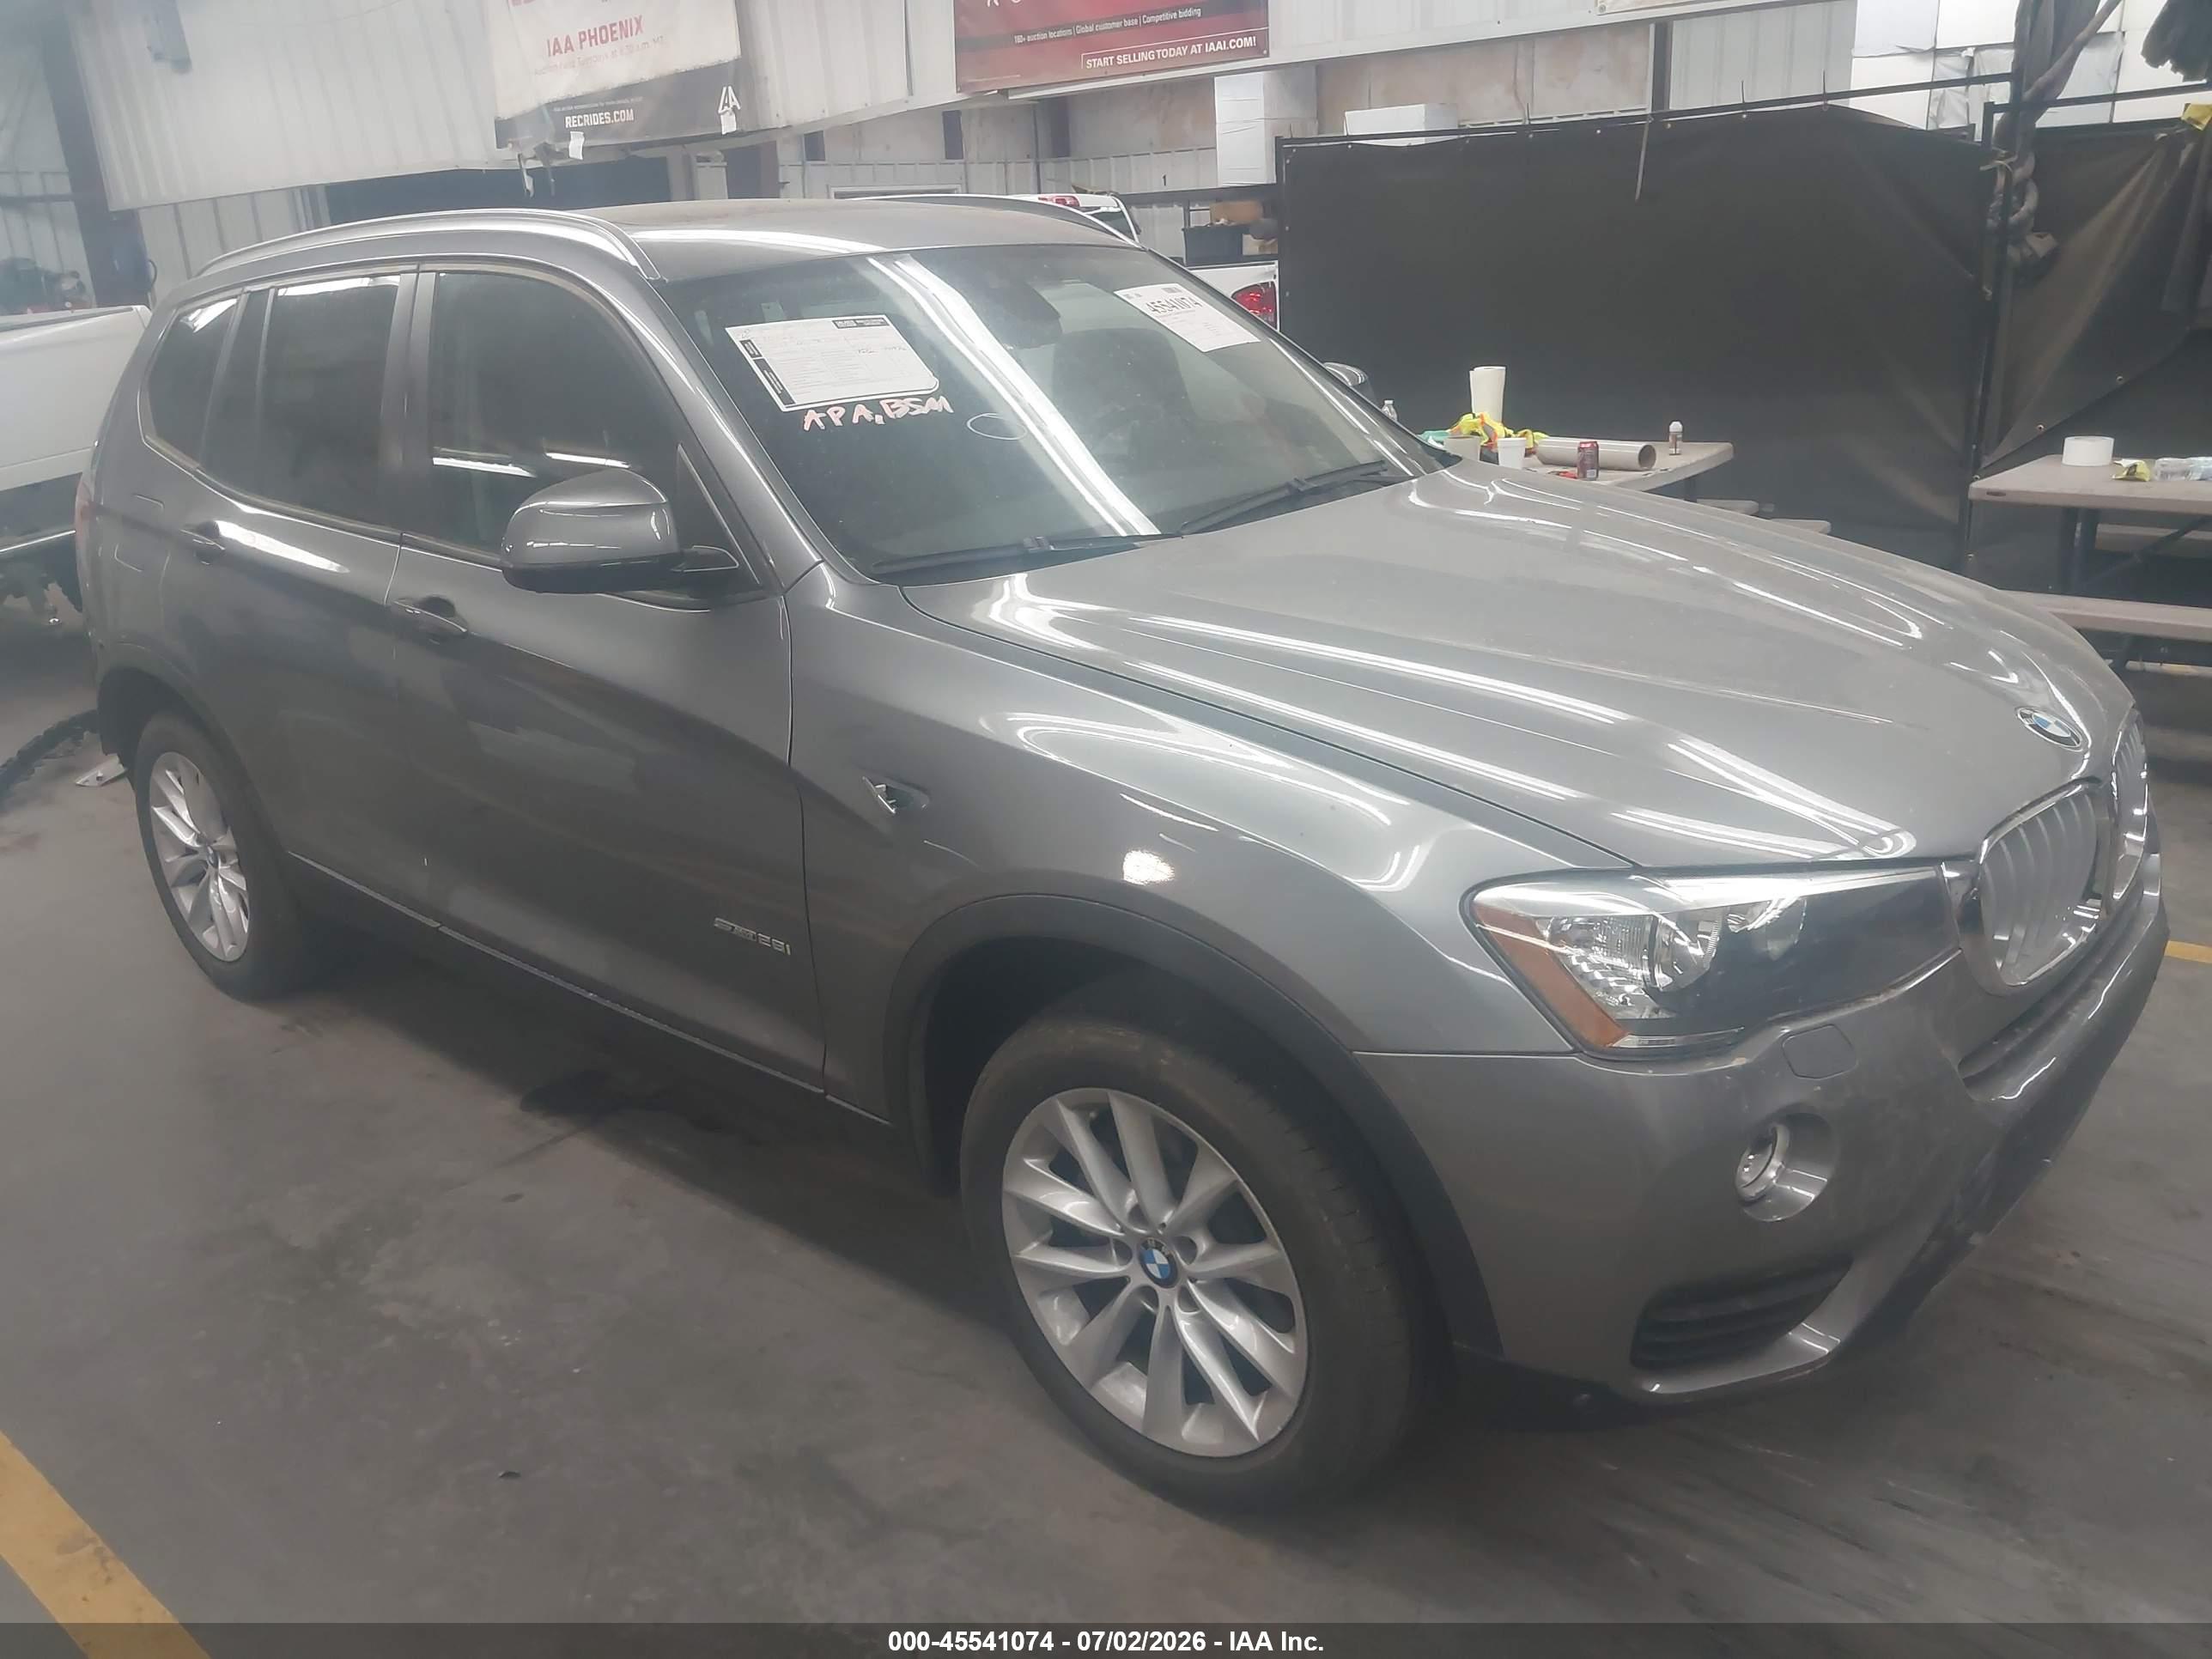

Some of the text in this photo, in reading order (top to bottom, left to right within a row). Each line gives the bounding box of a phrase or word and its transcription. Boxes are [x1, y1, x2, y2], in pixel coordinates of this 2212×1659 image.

[546, 35, 575, 58] IAA
[578, 15, 645, 50] PHOENIX
[1027, 32, 1048, 42] auction
[1048, 28, 1073, 39] locations
[1076, 23, 1094, 34] Global
[1095, 20, 1122, 31] customer
[1123, 17, 1139, 27] base
[1142, 11, 1177, 24] Competitive
[1178, 8, 1201, 18] bidding
[1085, 36, 1256, 70] START SELLING TODAY AT IAAI.COM!
[565, 108, 634, 128] RECRIDES.COM
[1146, 296, 1203, 314] 45541074
